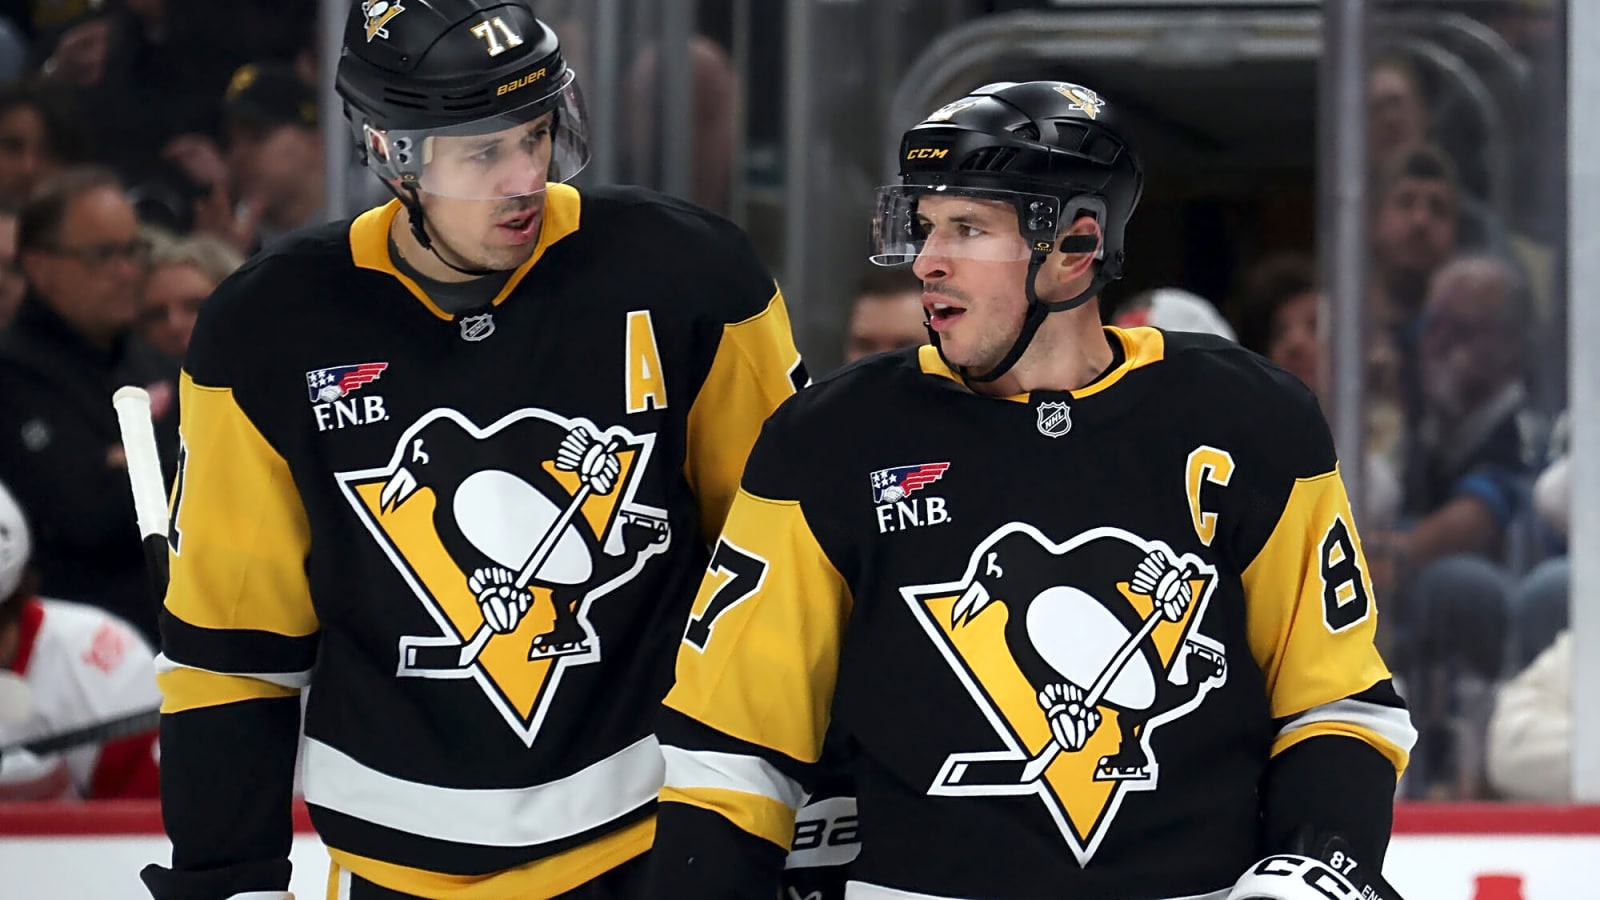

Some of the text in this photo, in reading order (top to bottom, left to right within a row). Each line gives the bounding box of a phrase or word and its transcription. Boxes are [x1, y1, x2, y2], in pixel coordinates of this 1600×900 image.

[469, 16, 524, 57] 71
[496, 67, 547, 97] BAUER
[906, 148, 950, 161] CCM
[625, 310, 668, 415] A
[312, 395, 390, 432] F.N.B.
[1044, 411, 1065, 430] NHL
[875, 496, 952, 534] F.N.B.
[1185, 445, 1236, 548] C
[1329, 851, 1358, 876] 87
